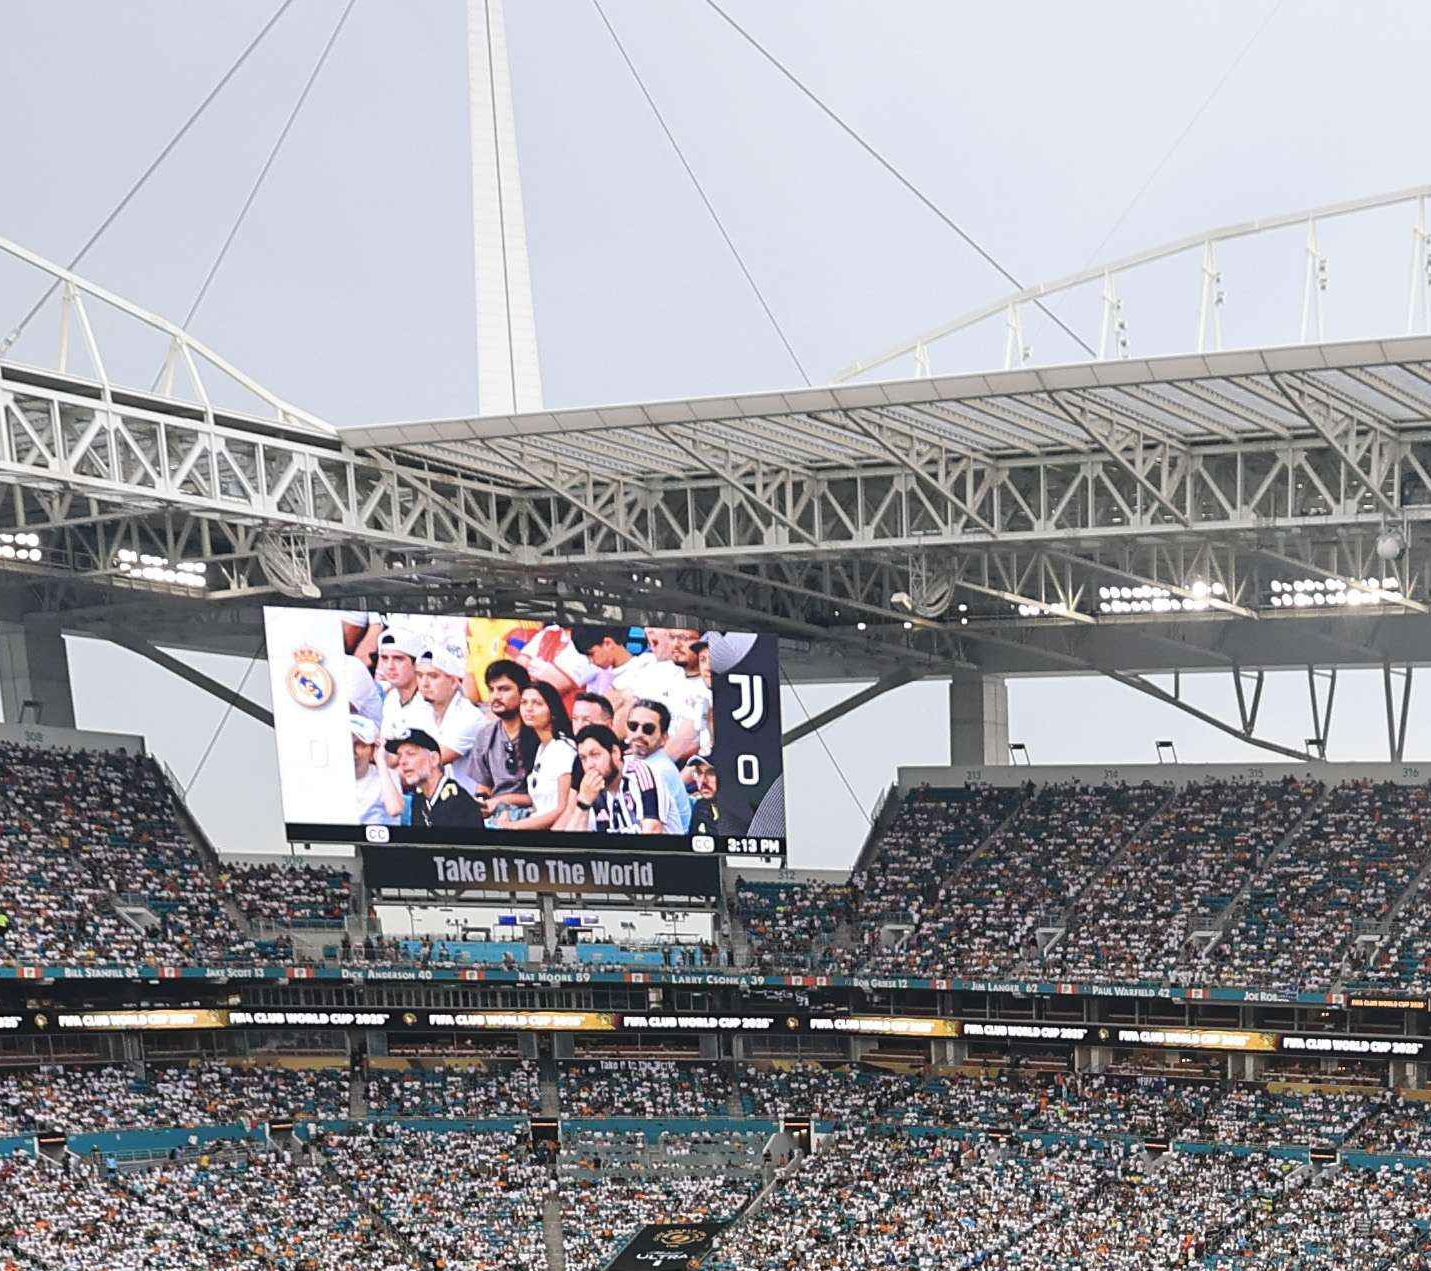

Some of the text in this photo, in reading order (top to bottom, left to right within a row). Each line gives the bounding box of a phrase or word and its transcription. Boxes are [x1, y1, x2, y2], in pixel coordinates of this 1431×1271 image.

[737, 754, 759, 787] 0
[760, 839, 781, 855] PM
[434, 856, 654, 887] Take It To The World
